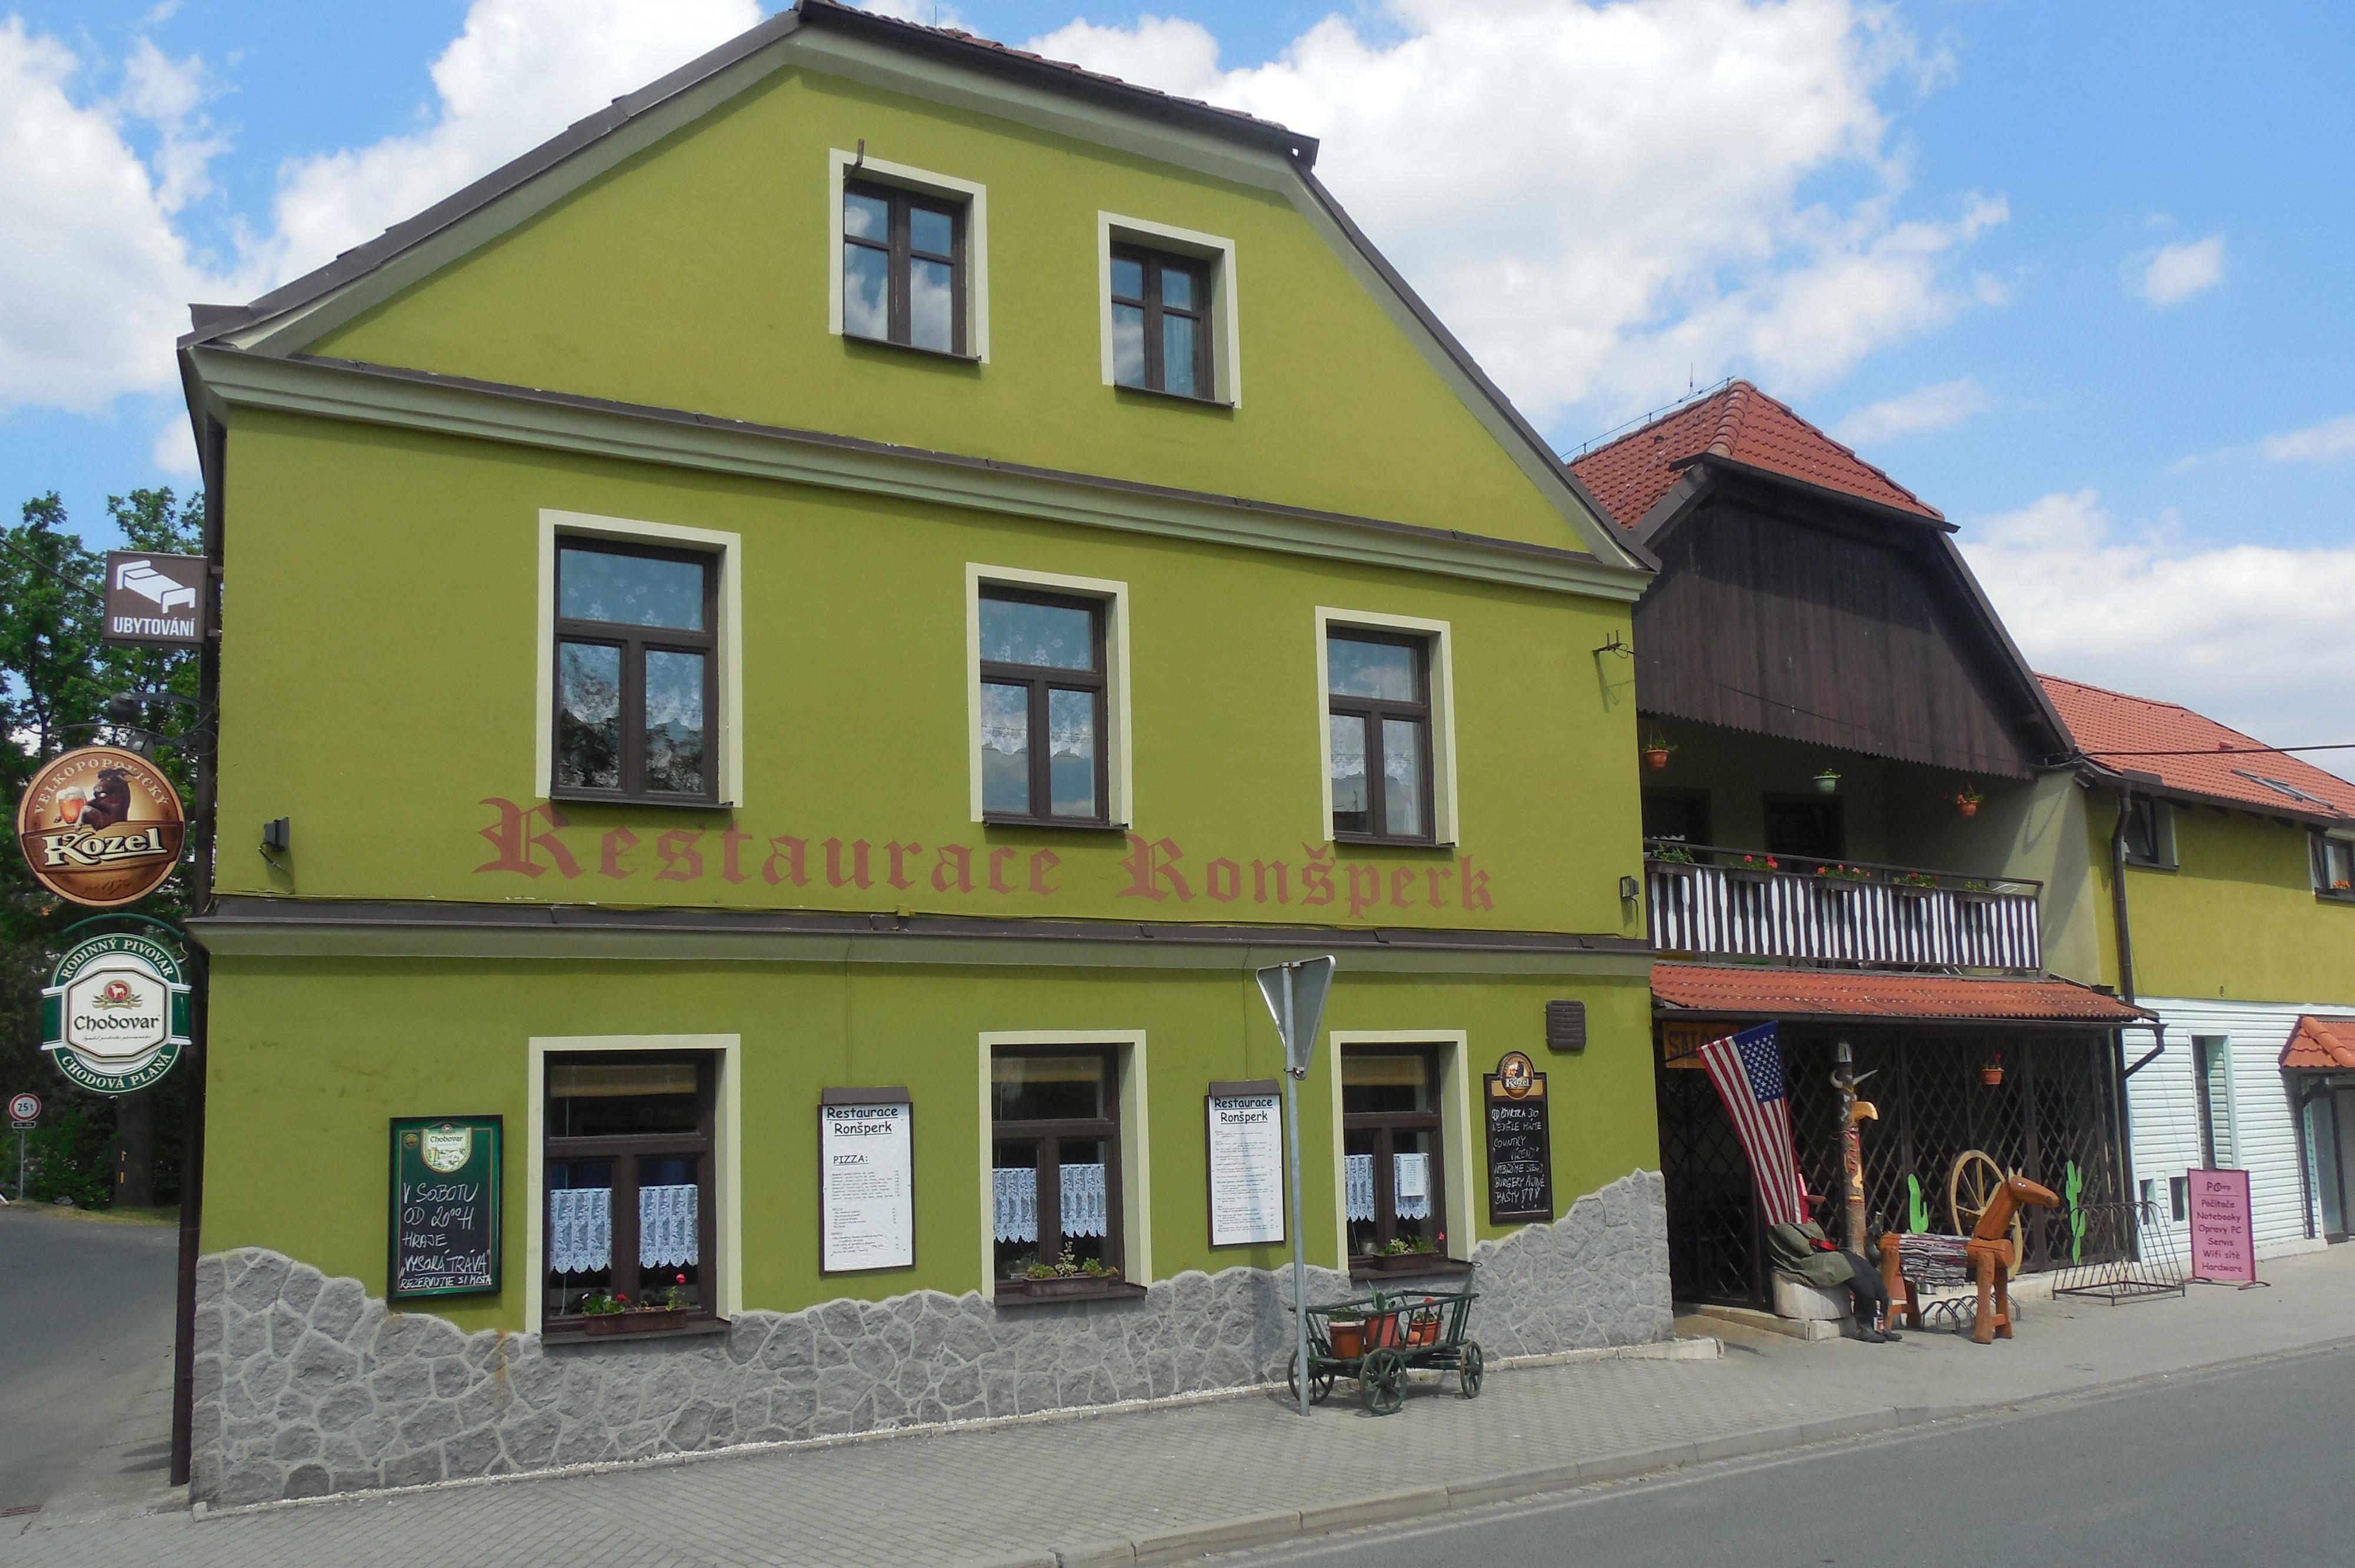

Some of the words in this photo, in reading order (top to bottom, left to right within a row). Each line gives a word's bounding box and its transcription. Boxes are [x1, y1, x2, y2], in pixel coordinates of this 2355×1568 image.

[114, 616, 195, 637] UBYTOVÁNÍ
[42, 827, 167, 866] Kozel
[473, 797, 1062, 896] Restaurace
[1116, 833, 1495, 919] Ronšperk
[60, 937, 118, 979] RODINNÝ
[123, 939, 174, 977] PIVOVAR
[74, 1014, 159, 1031] Chodovar
[62, 1055, 124, 1089] CHODOVÁ
[130, 1051, 172, 1082] PLANÁ
[18, 1102, 28, 1112] 25
[1215, 1098, 1272, 1108] Restaurace
[827, 1106, 898, 1118] Restaurace
[1220, 1110, 1268, 1124] Ronšperk
[834, 1121, 892, 1137] Ronšperk
[833, 1155, 868, 1164] PIZZA:
[403, 1182, 411, 1204] V
[416, 1182, 479, 1203] SOBOTU
[404, 1207, 424, 1225] OD
[2197, 1211, 2241, 1223] Notebooky
[2198, 1224, 2227, 1234] Opravy
[2231, 1225, 2241, 1234] PC
[402, 1231, 447, 1248] HRAJE
[2208, 1237, 2234, 1246] Servis
[2202, 1263, 2243, 1272] Hardware
[457, 1275, 467, 1285] SI
